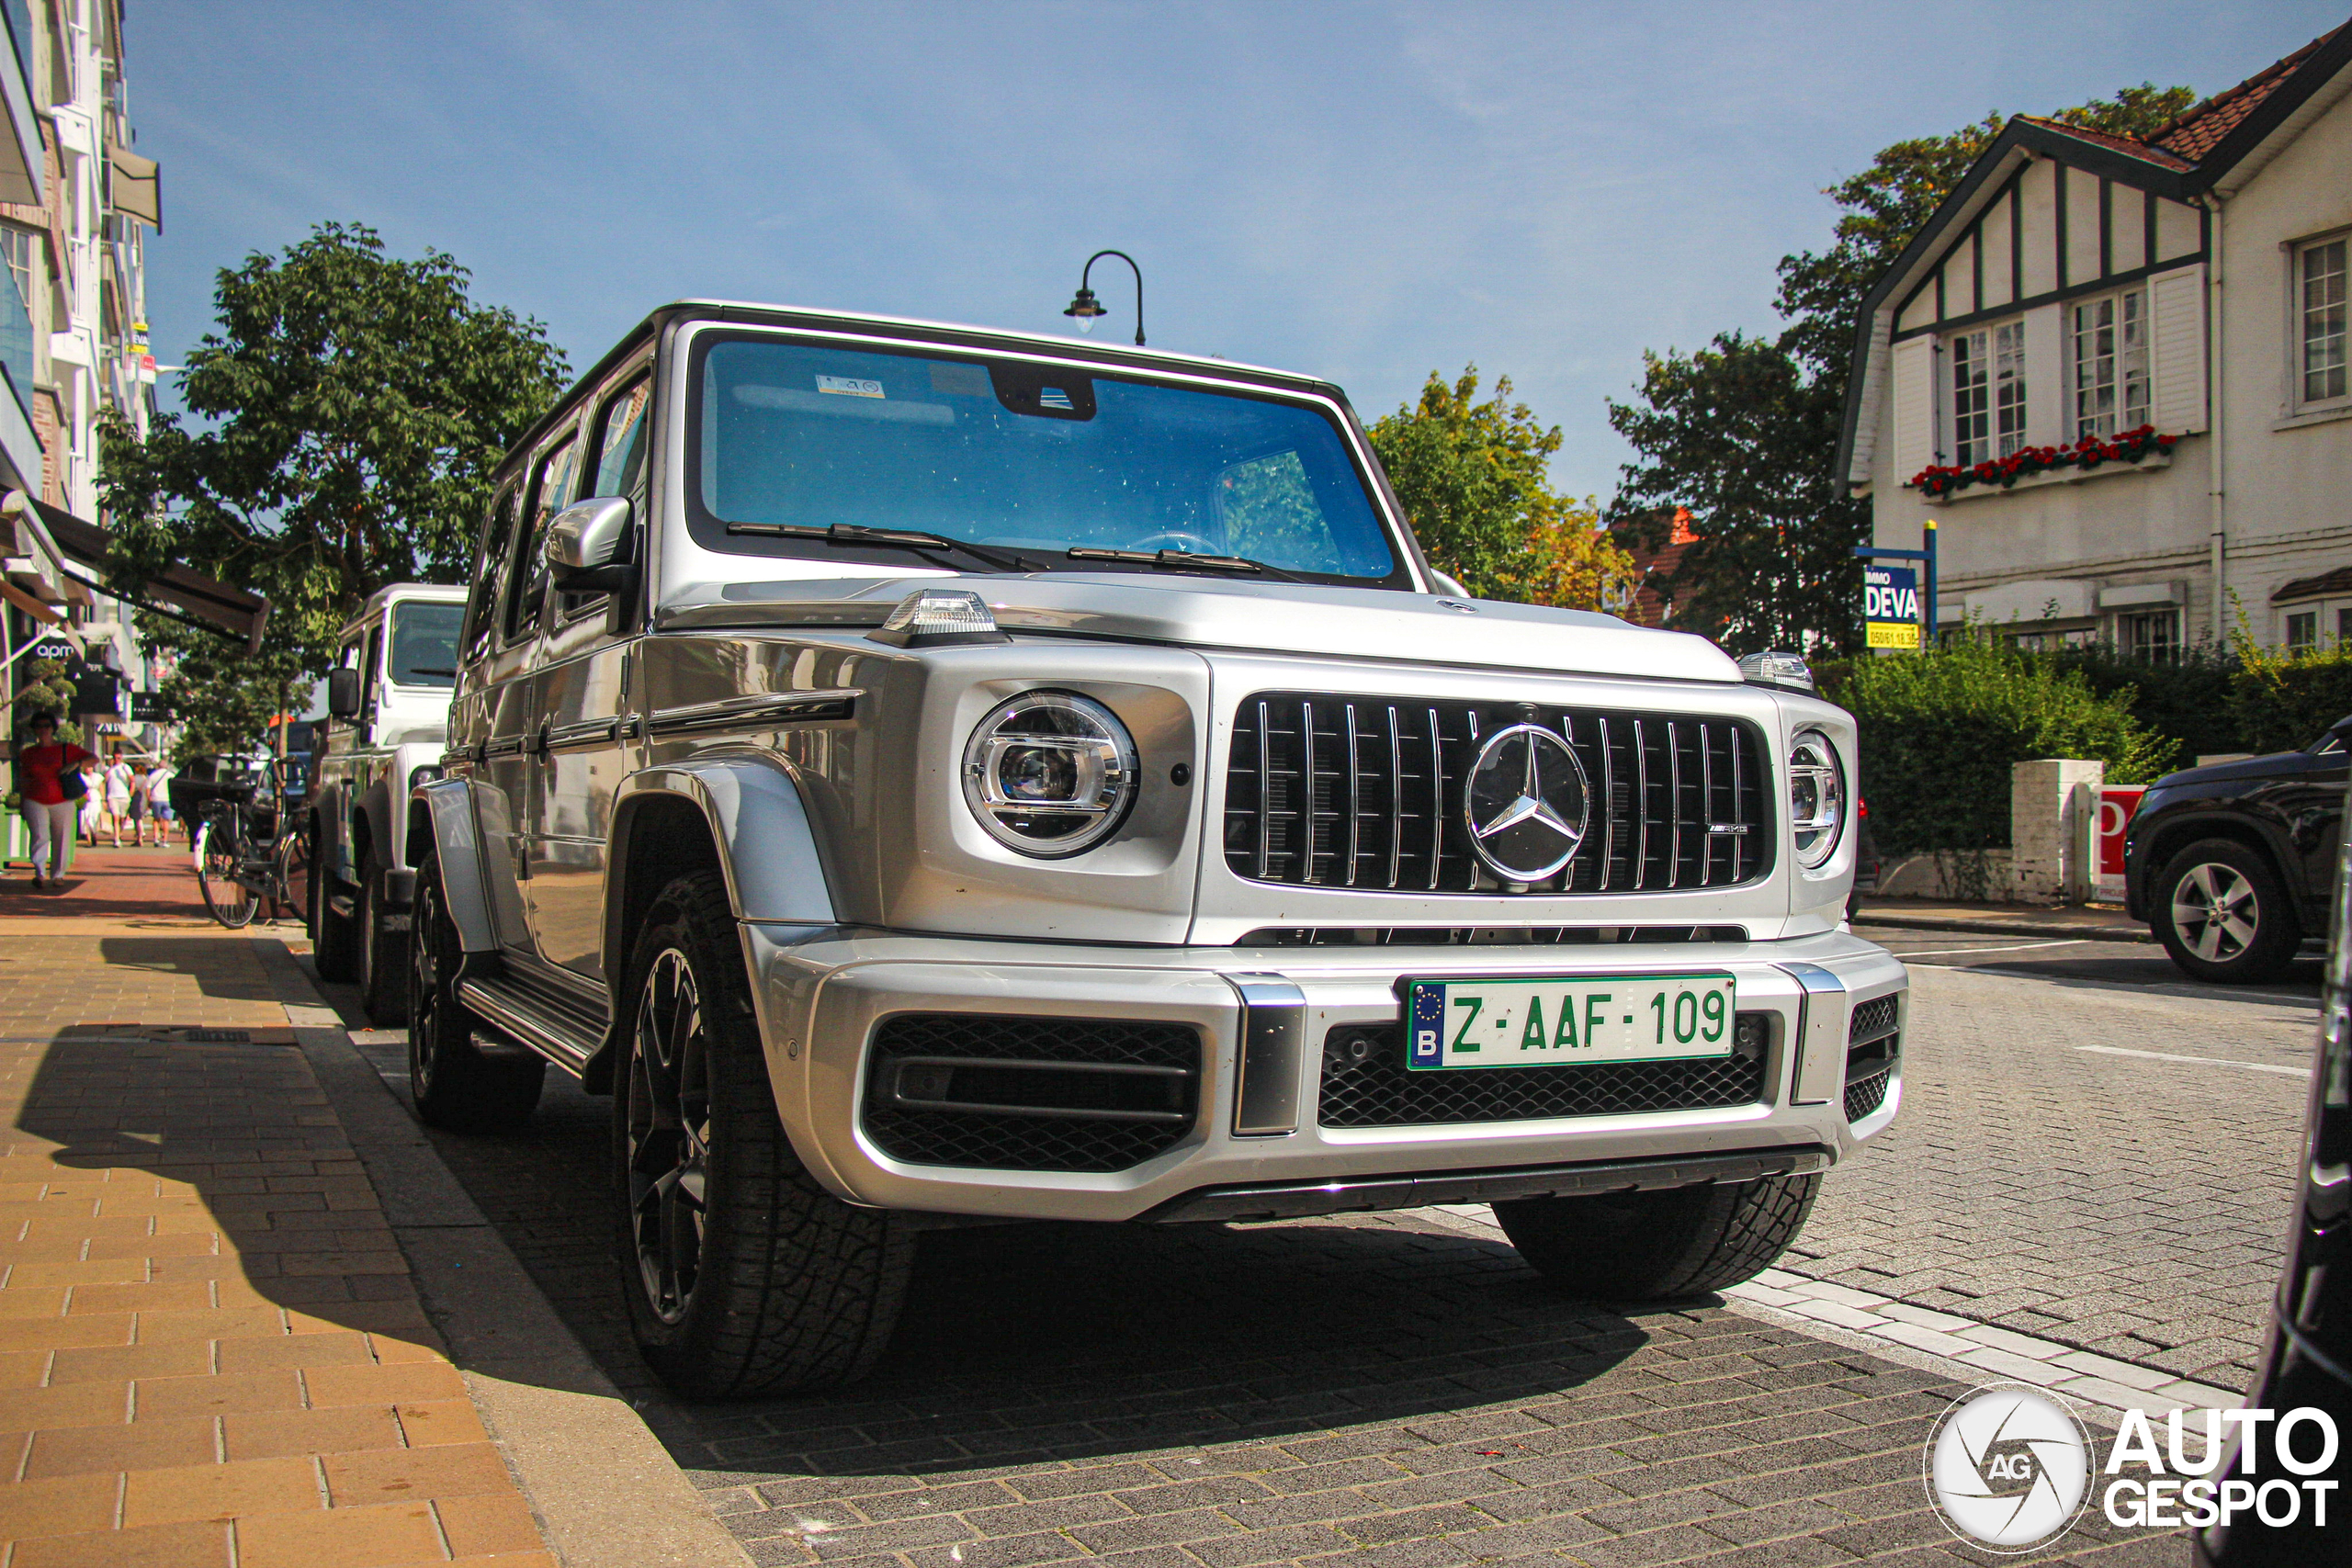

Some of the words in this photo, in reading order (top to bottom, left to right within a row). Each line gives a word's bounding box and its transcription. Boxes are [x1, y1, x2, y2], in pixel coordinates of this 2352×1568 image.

[1865, 571, 1891, 585] IMMO
[1866, 586, 1918, 618] DEVA
[37, 645, 74, 660] apm
[1418, 1030, 1437, 1056] B
